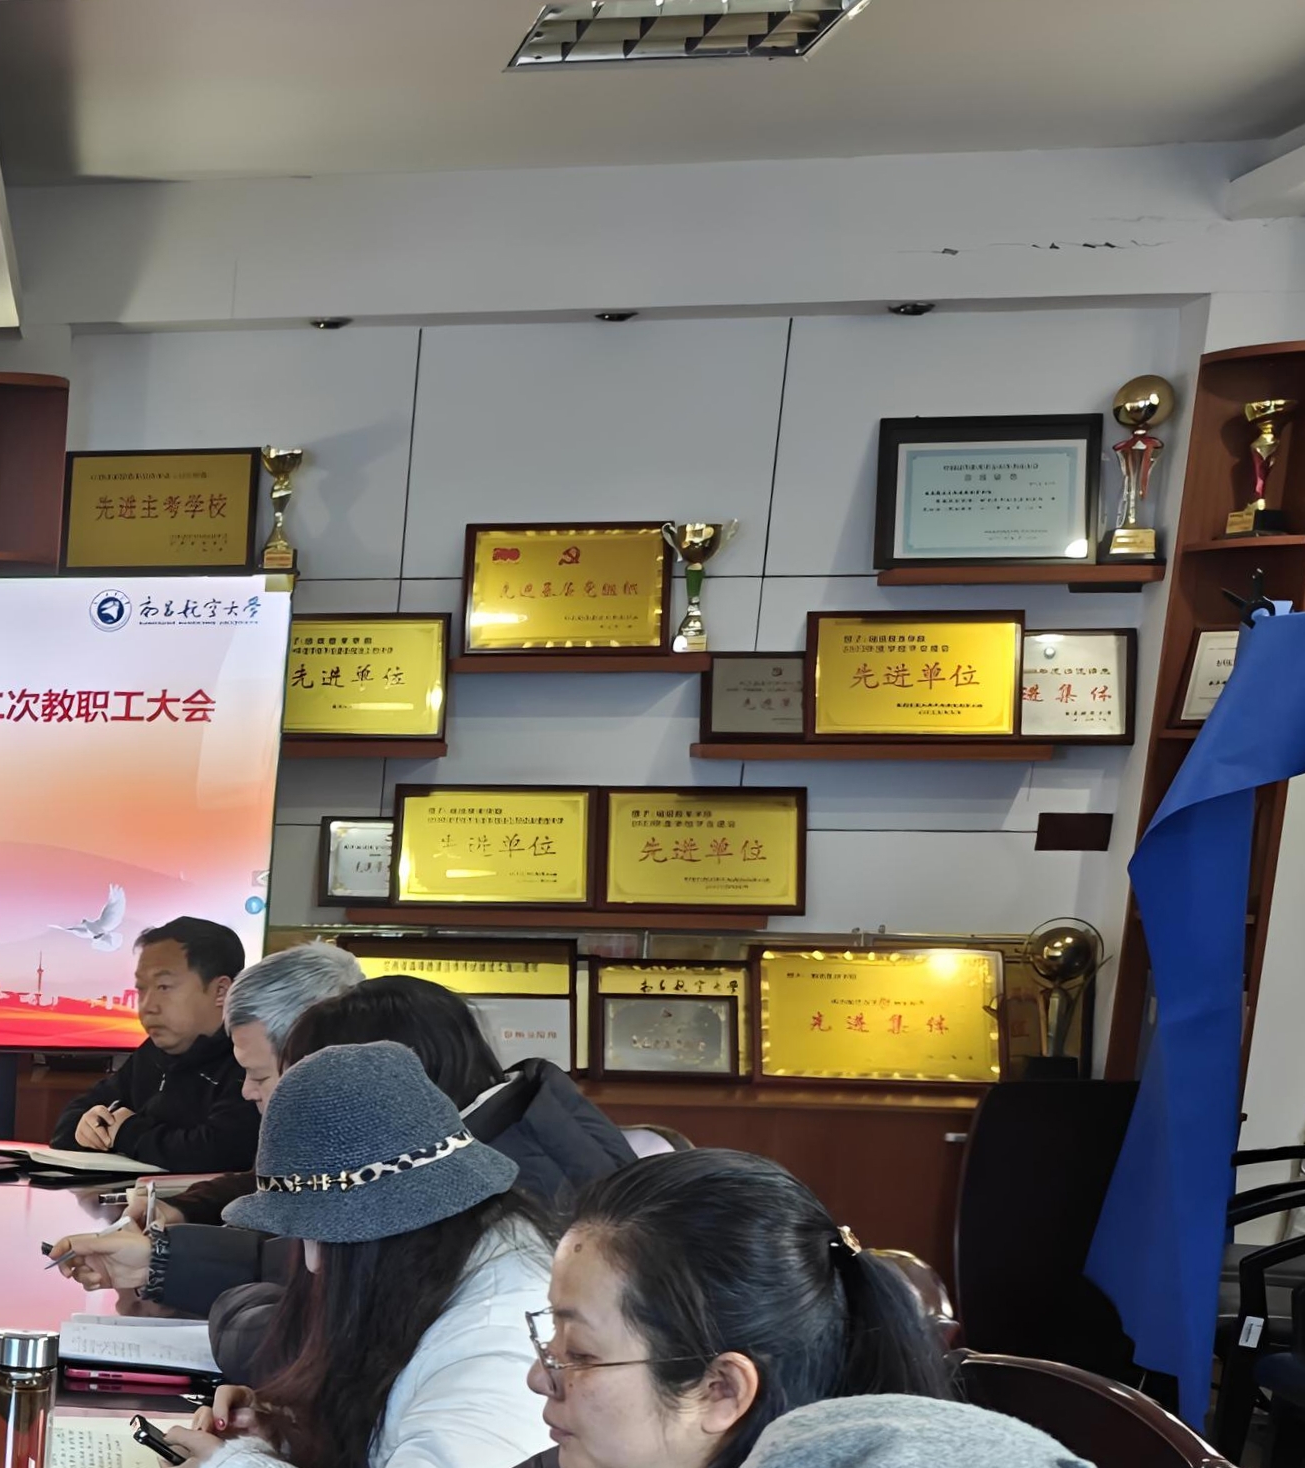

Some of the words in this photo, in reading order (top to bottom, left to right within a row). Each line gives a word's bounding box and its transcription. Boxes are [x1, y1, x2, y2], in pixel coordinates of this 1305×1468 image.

[95, 493, 229, 521] 先进主考学校
[140, 596, 262, 618] 南昌航空大学
[291, 663, 407, 690] 先进单位
[850, 662, 980, 690] 先进单位
[433, 833, 557, 858] 先进单位
[639, 837, 767, 864] 先进单位
[811, 1011, 949, 1035] 先进集体
